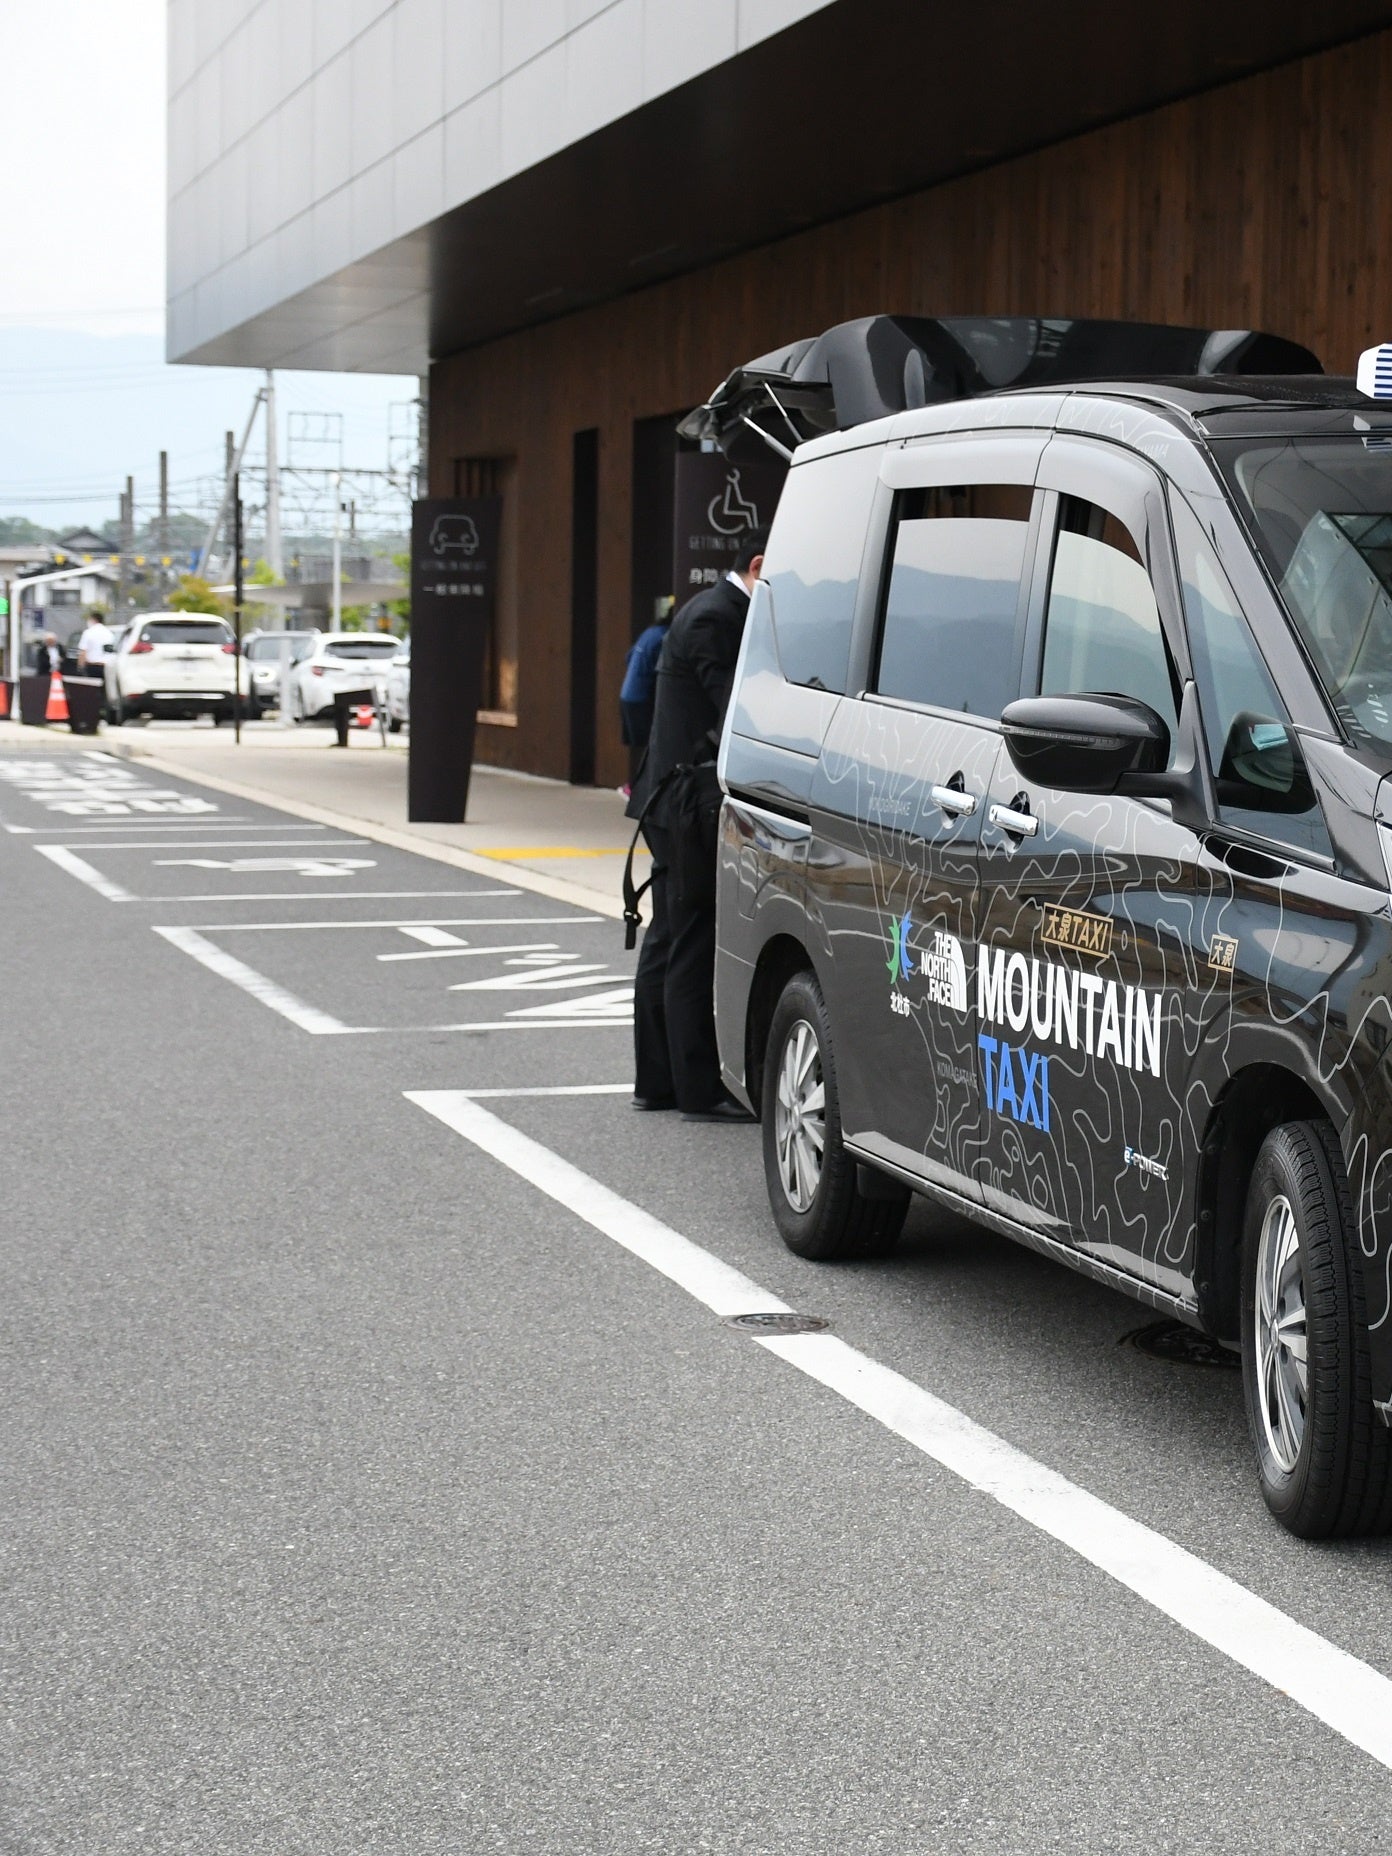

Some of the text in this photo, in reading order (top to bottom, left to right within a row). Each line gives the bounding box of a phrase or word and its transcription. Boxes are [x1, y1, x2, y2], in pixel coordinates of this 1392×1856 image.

[934, 931, 952, 959] THE
[1045, 909, 1110, 953] 大泉TAXI
[921, 951, 952, 984] NORTH
[1211, 940, 1234, 967] 大泉
[890, 991, 910, 1018] 北杜市
[928, 978, 952, 1008] FACE
[977, 943, 1162, 1078] MOUNTAIN
[977, 1033, 1050, 1133] TAXI
